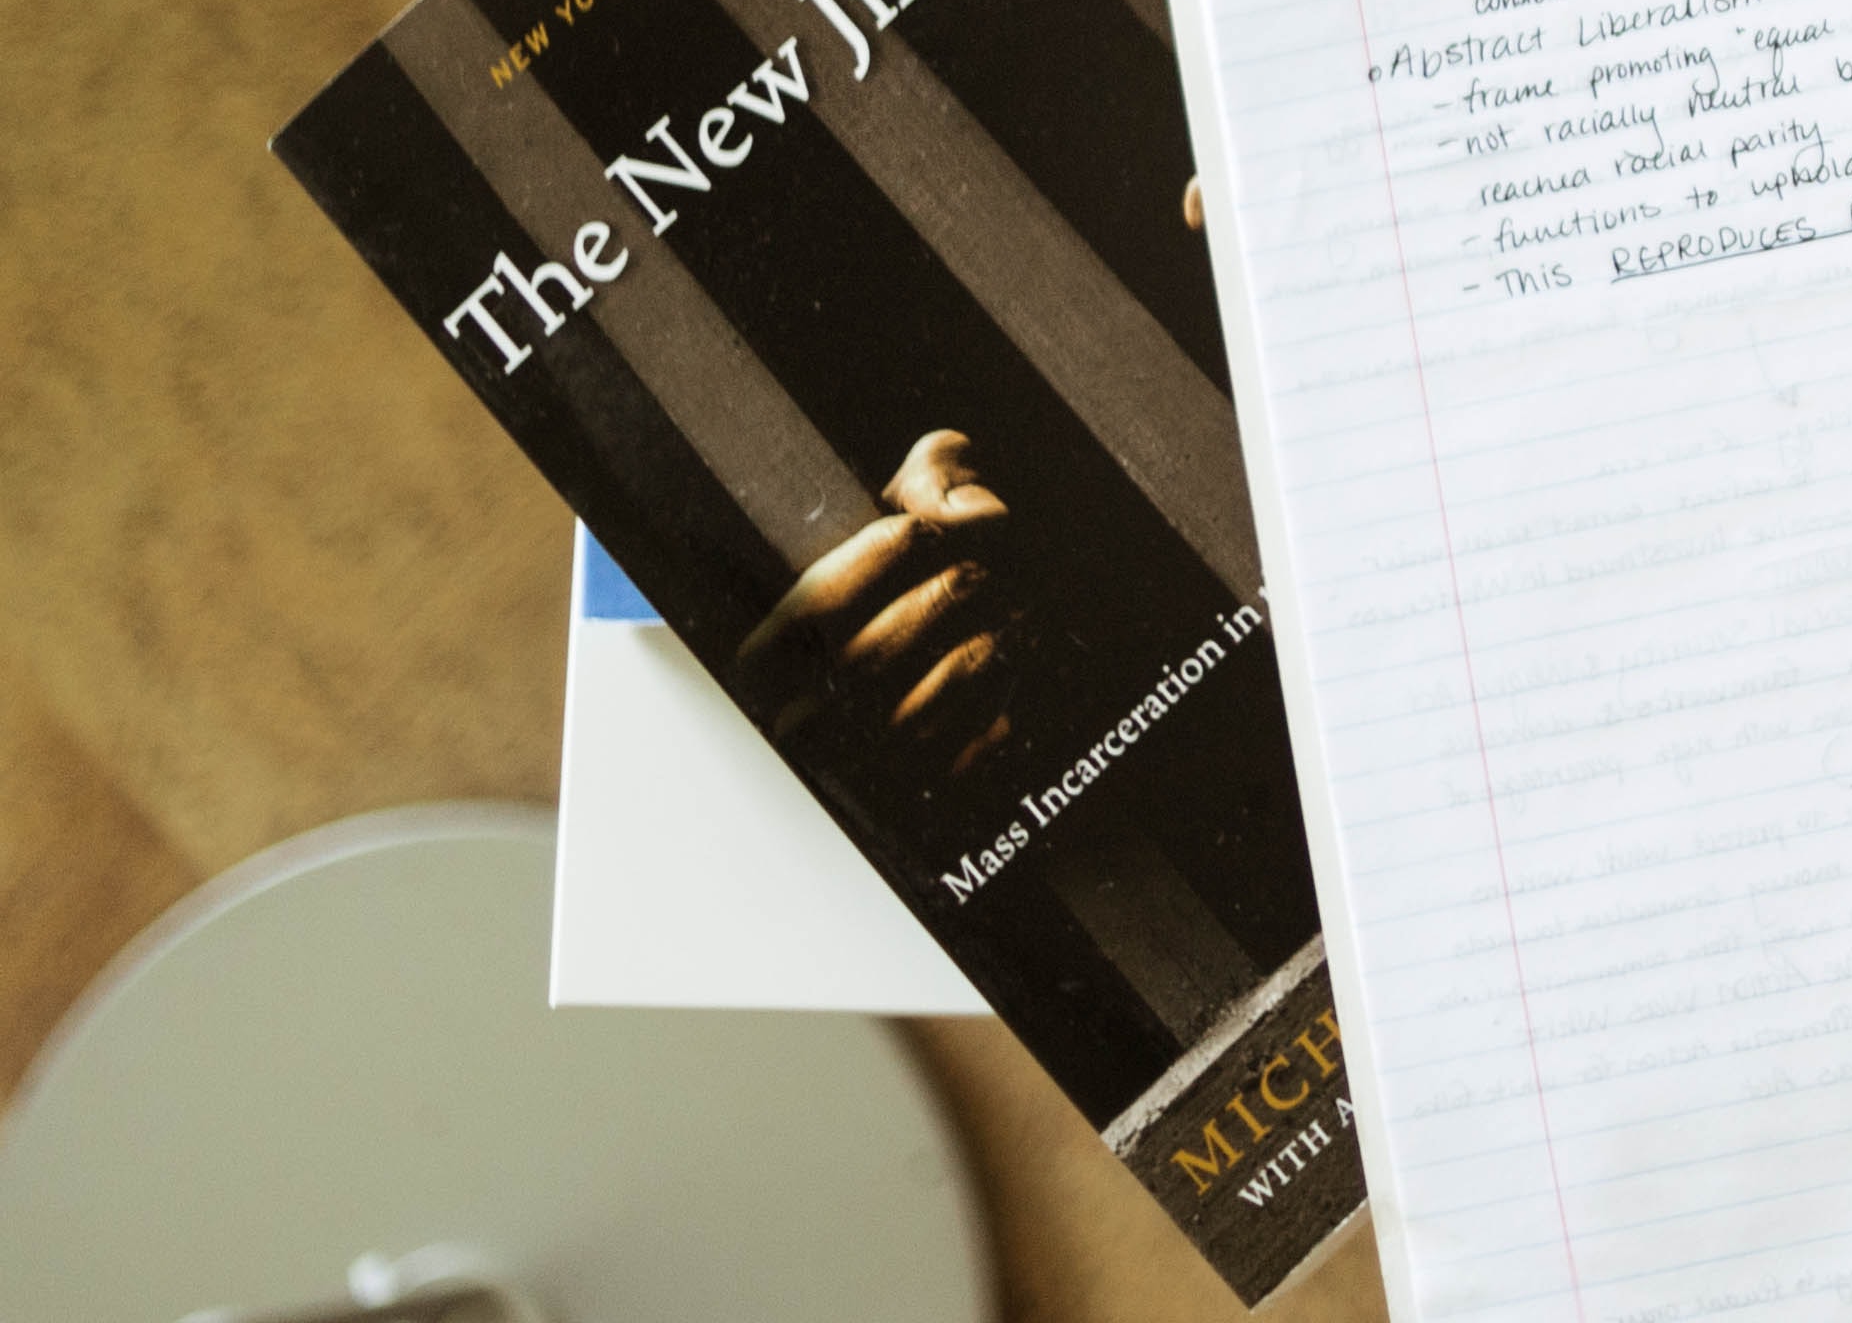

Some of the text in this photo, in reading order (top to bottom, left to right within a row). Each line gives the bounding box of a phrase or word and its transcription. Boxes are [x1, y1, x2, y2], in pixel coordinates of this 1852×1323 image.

[488, 24, 552, 91] NEW
[1389, 26, 1546, 82] Abstract
[443, 217, 630, 377] The
[604, 37, 818, 239] New
[1611, 217, 1818, 277] REPRODUCES
[939, 599, 1265, 907] Mass Incarceration in
[1237, 1119, 1332, 1207] WITH
